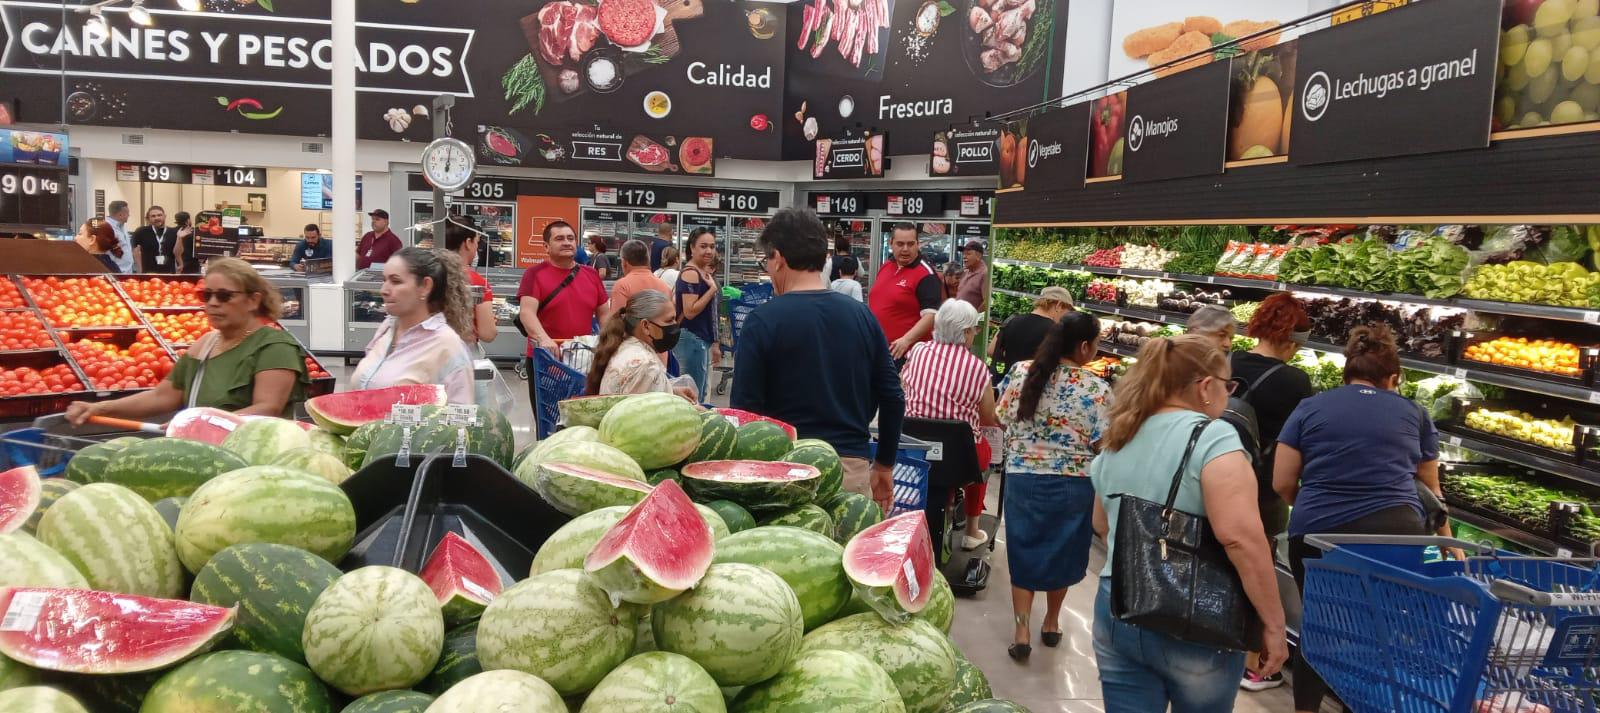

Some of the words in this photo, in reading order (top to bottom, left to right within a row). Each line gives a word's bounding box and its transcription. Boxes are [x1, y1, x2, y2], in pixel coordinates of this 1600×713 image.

[21, 22, 190, 62] CARNES
[201, 31, 228, 63] Y
[687, 62, 771, 88] Calidad
[1335, 74, 1404, 98] Lechugas
[1407, 68, 1417, 86] a
[1420, 49, 1477, 90] granel
[879, 95, 953, 120] Frescura
[1145, 117, 1178, 137] Manojos
[588, 146, 606, 156] RES
[836, 152, 859, 163] CERDO
[961, 147, 988, 158] POLLO
[1038, 141, 1062, 159] Vegetales
[41, 179, 58, 194] Kg
